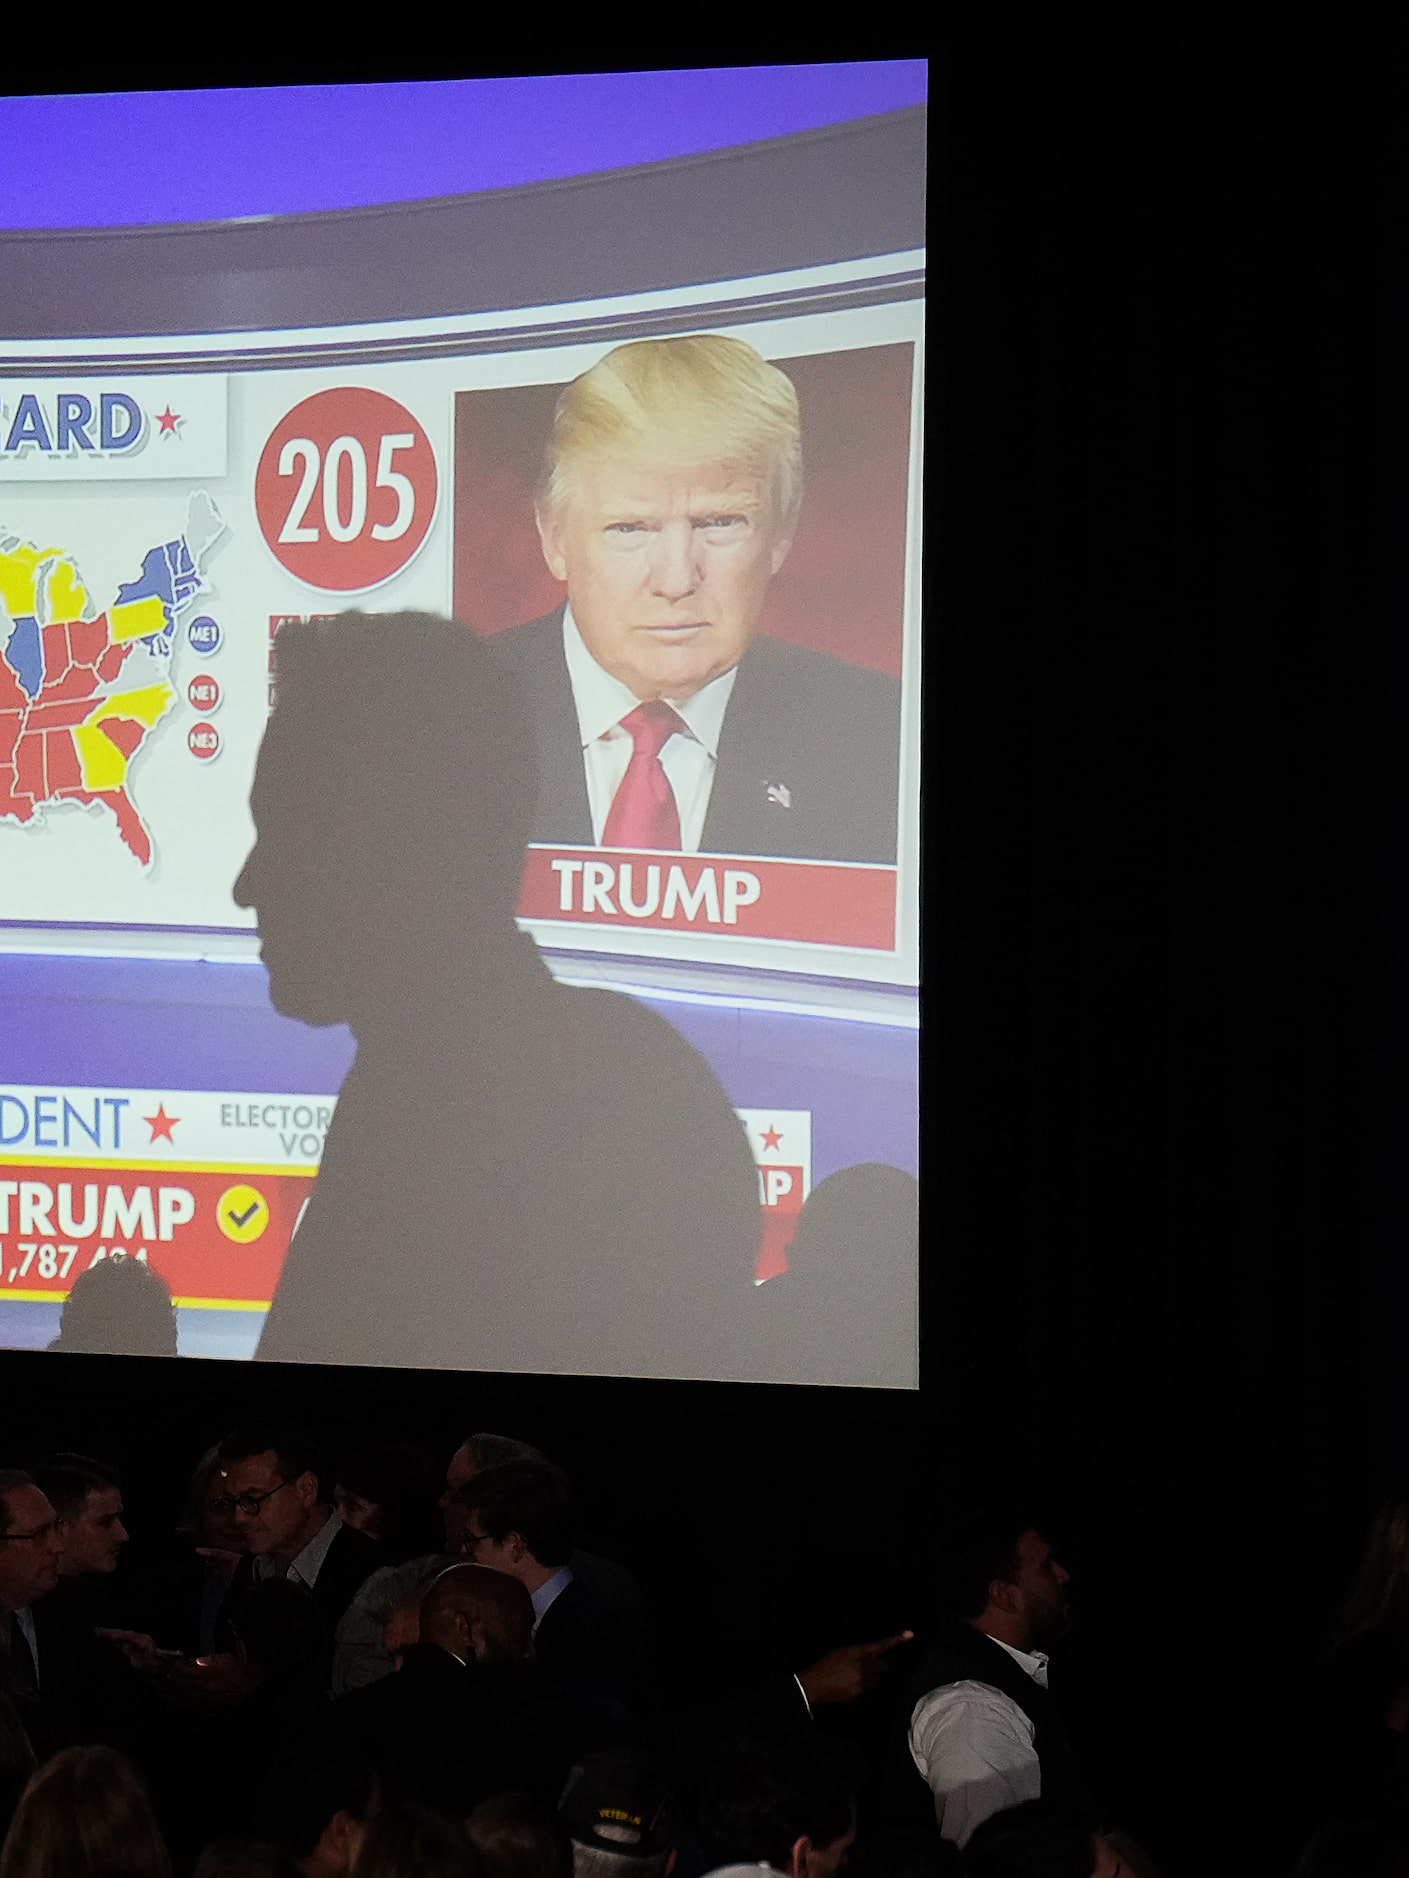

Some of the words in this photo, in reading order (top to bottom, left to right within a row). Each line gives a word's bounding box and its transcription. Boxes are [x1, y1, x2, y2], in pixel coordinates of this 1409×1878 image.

[277, 433, 416, 543] 205
[190, 625, 218, 642] ME1
[550, 859, 761, 924] TRUMP
[278, 1132, 326, 1157] VO
